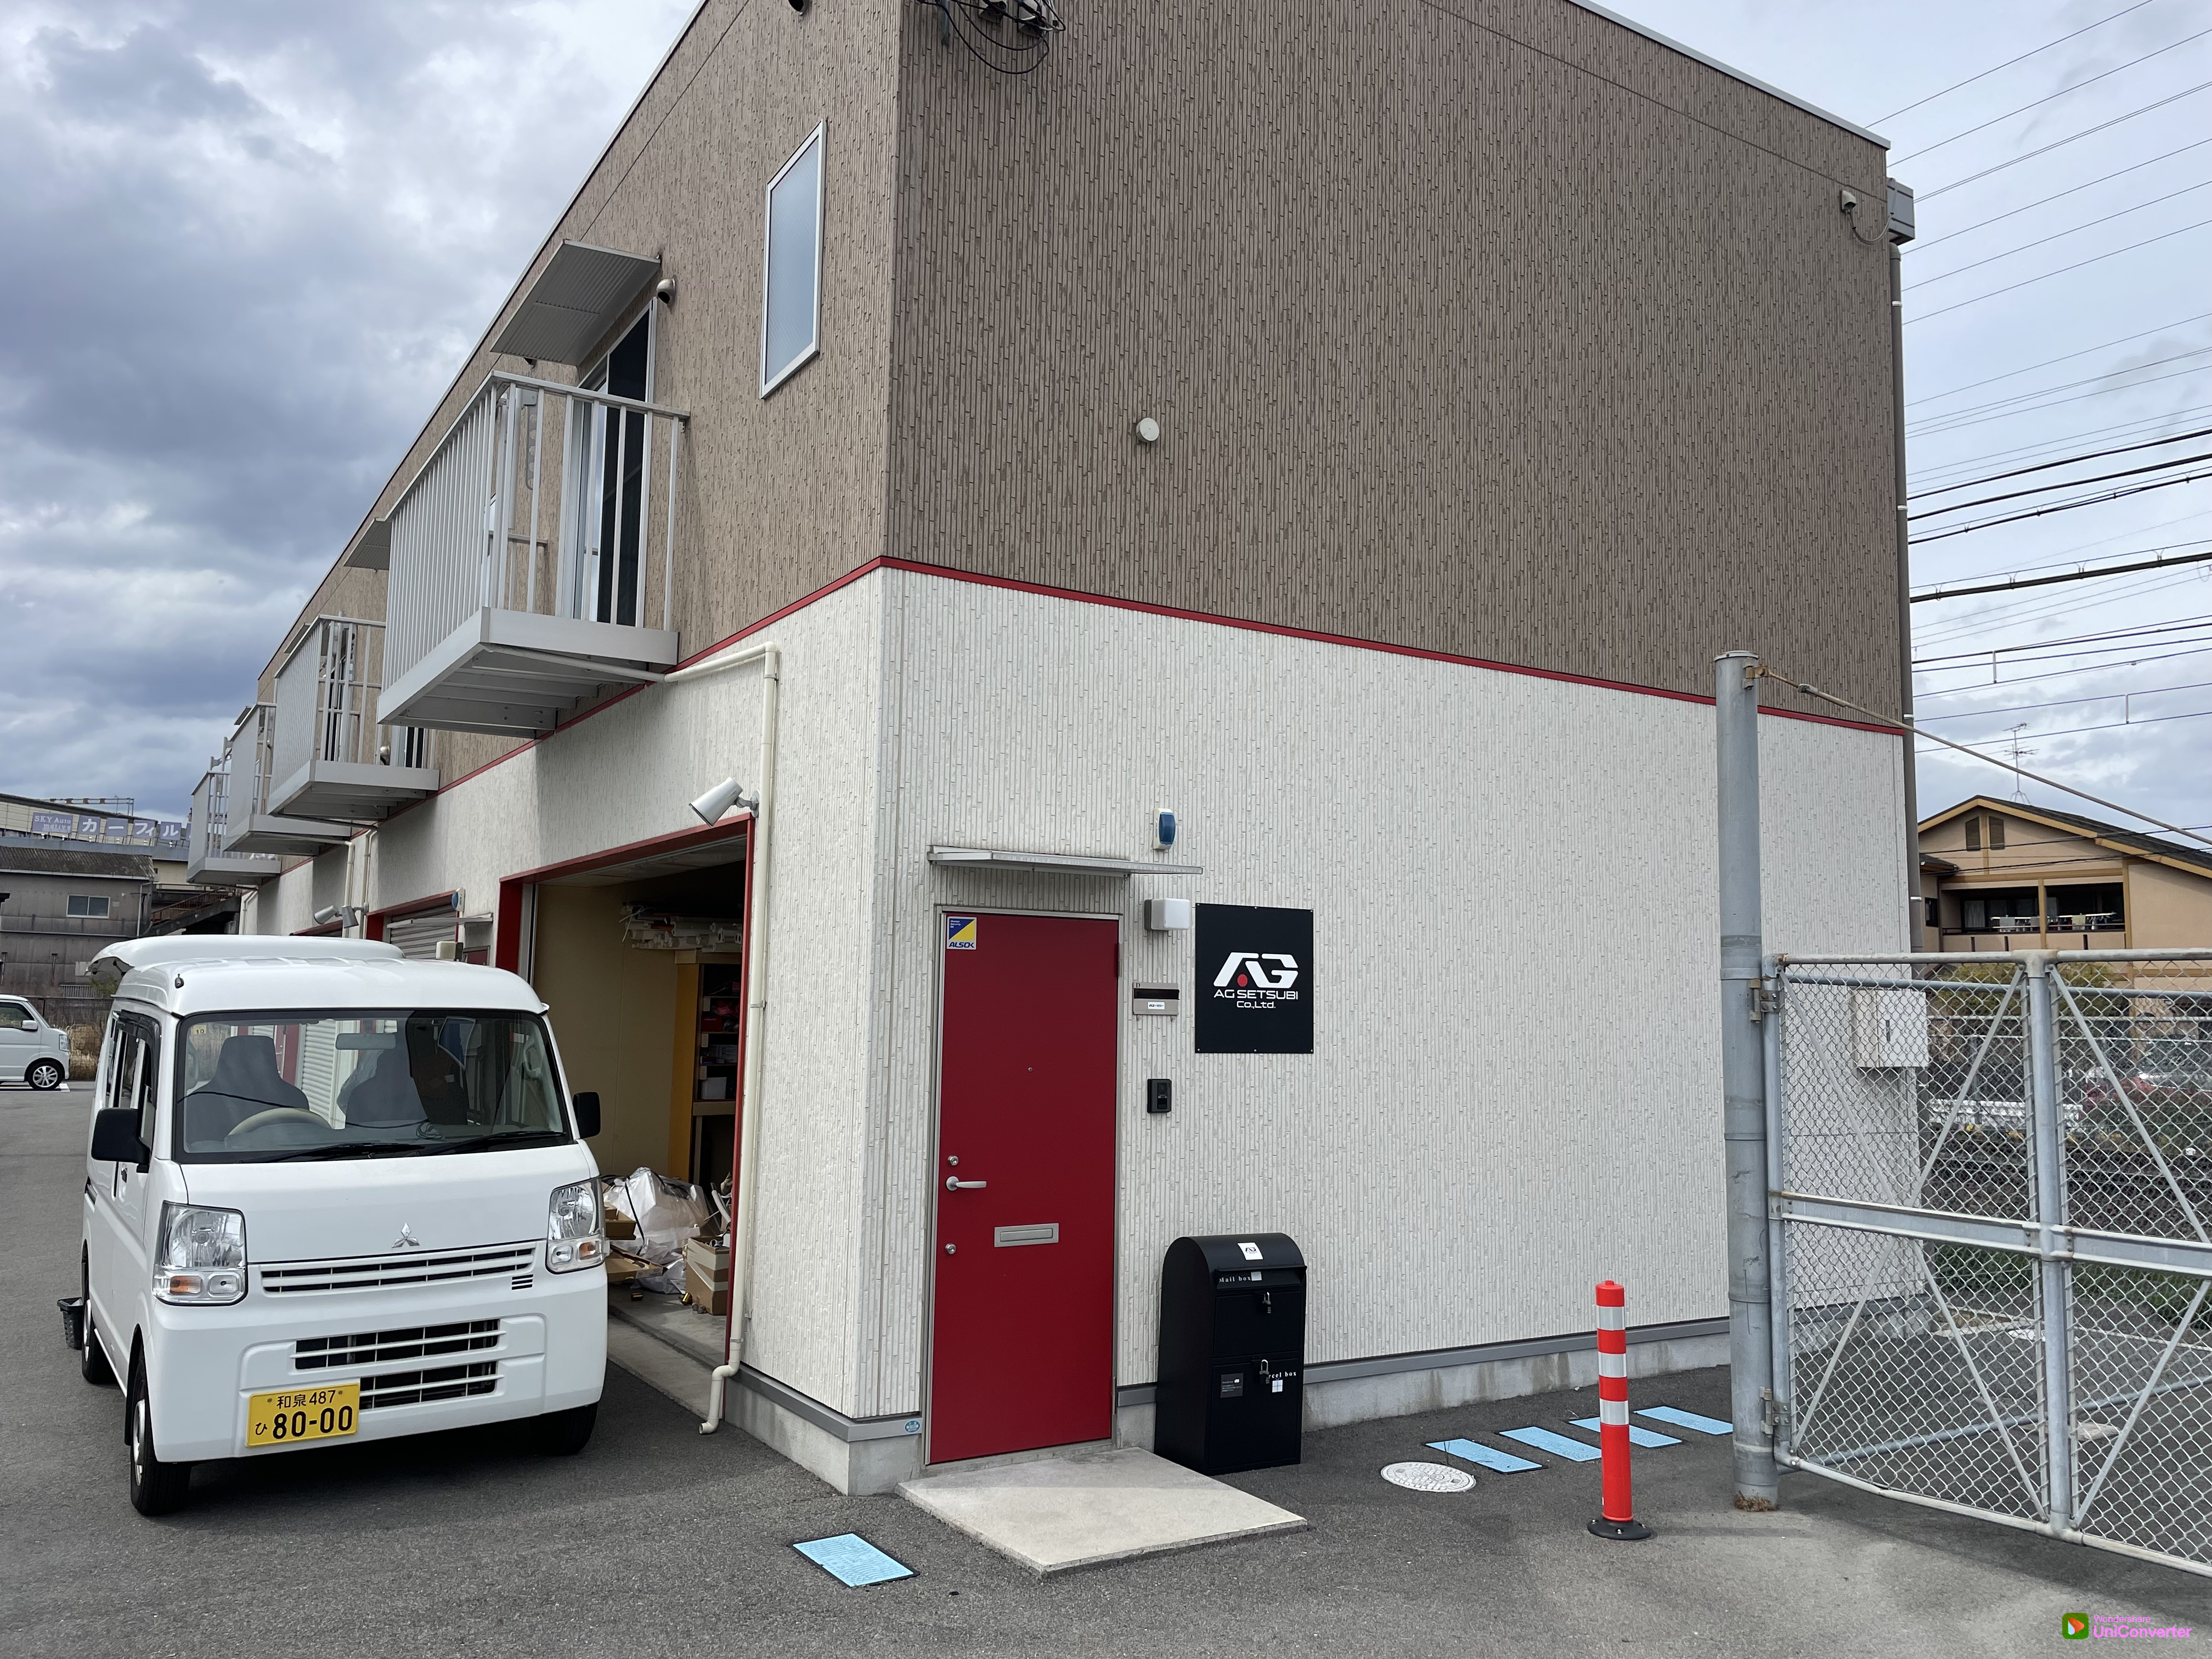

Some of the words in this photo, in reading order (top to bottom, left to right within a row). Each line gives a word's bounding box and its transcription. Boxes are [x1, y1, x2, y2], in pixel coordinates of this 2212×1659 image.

[82, 818, 191, 840] カーフィル
[1214, 989, 1235, 998] AG
[1237, 990, 1299, 1000] SETSUBI
[1236, 1001, 1277, 1009] Co.,Ltd.
[276, 1394, 307, 1409] 和泉
[309, 1390, 336, 1406] 487
[255, 1422, 268, 1436] ひ
[273, 1405, 353, 1440] 80-00
